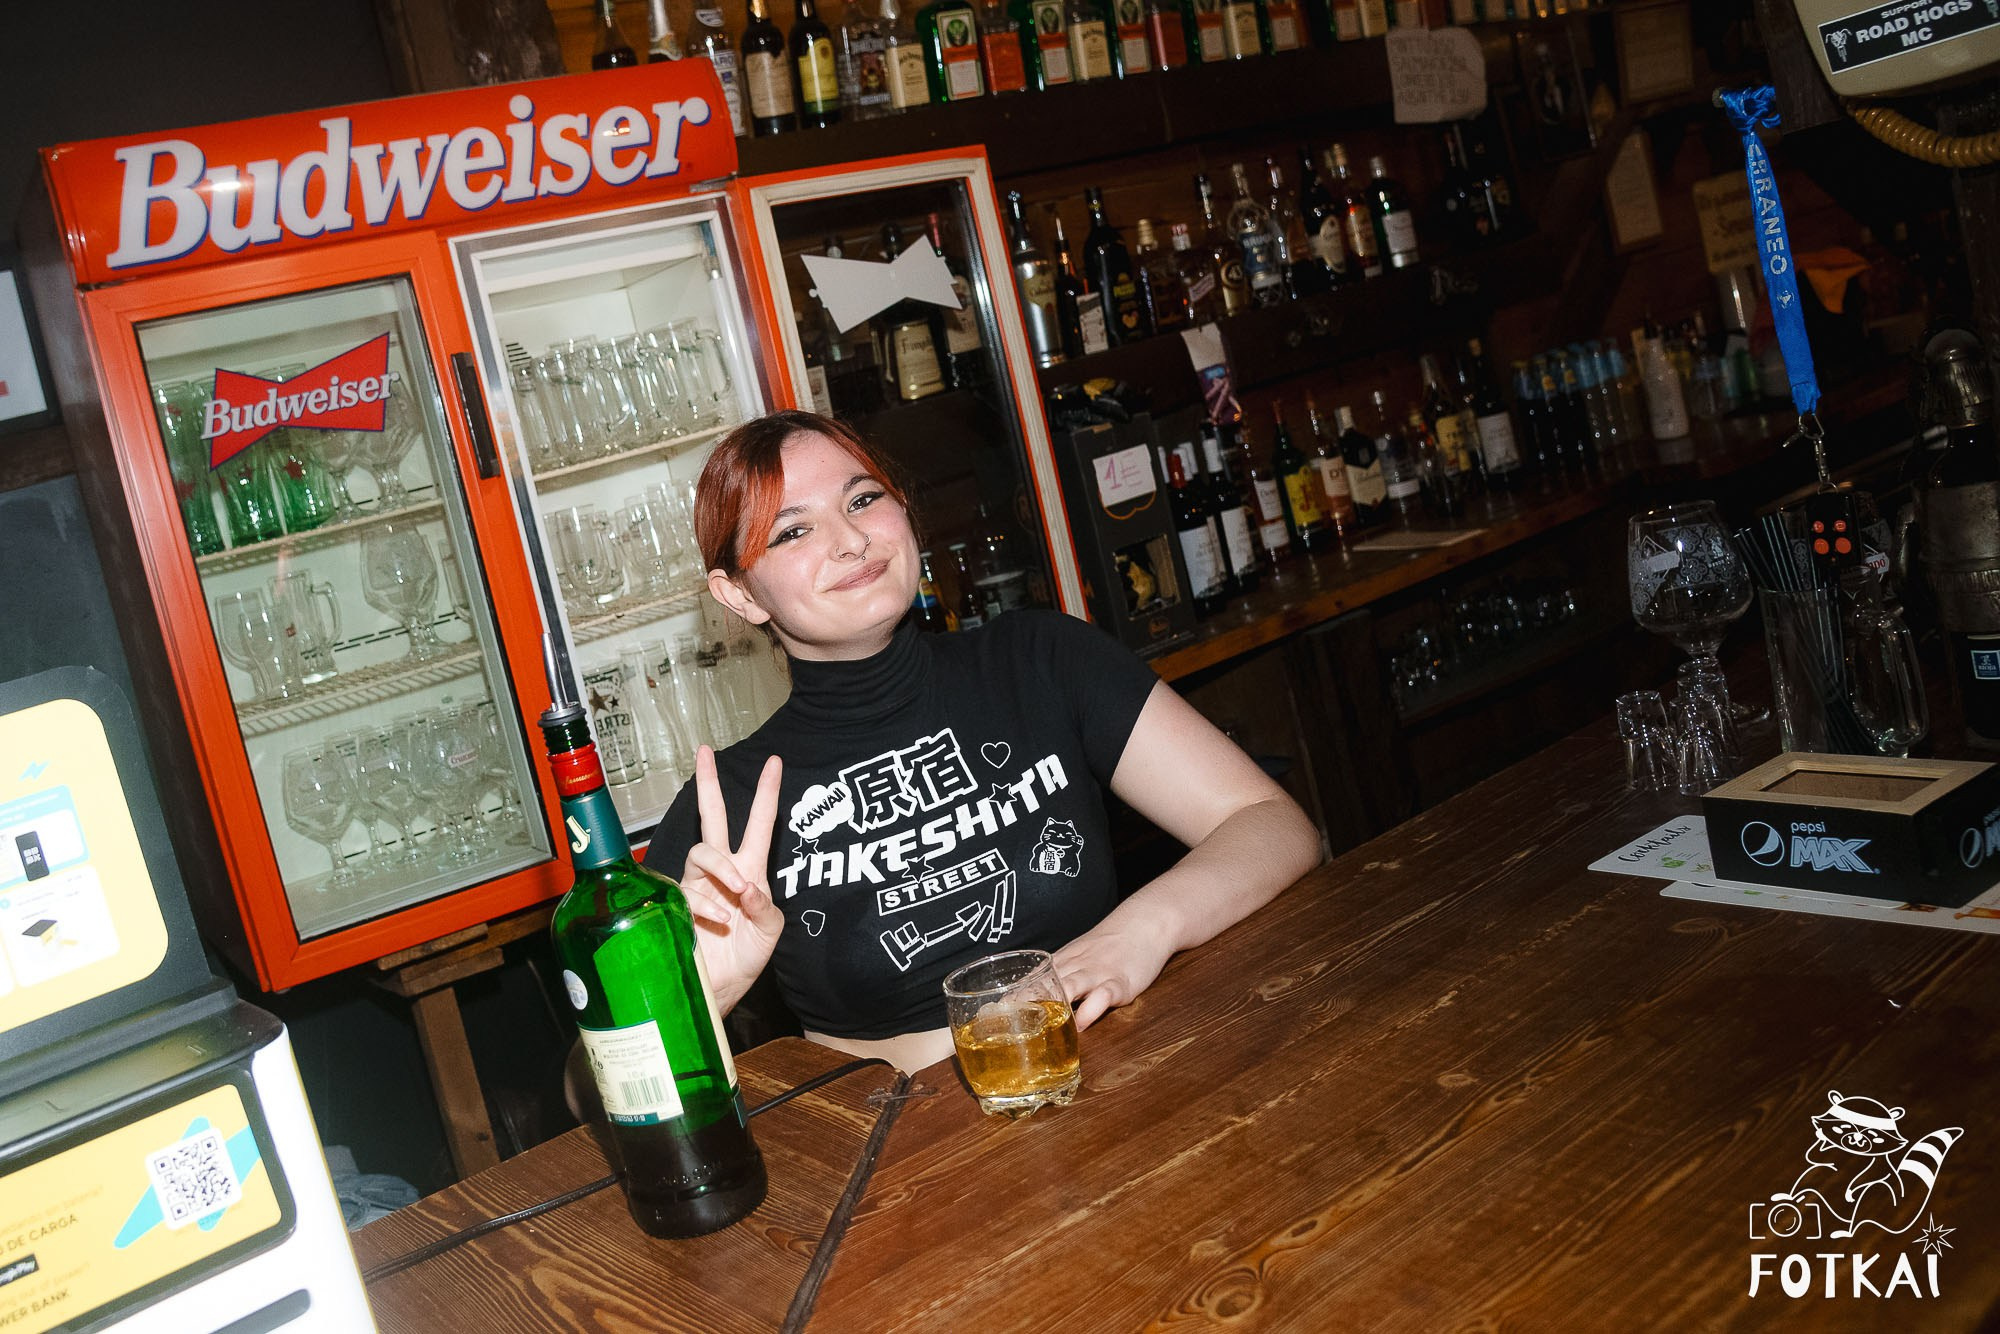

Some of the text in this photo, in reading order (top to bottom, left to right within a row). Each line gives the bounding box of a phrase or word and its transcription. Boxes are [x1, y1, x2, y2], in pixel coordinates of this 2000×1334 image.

[1856, 0, 1973, 43] ROAD HOGS
[1900, 27, 1933, 47] MC
[107, 95, 711, 269] Budweiser
[200, 371, 401, 440] Budweiser
[839, 727, 978, 834] 原宿
[776, 753, 1069, 899] TAKESHITA
[795, 787, 844, 832] KAWAII
[1790, 821, 1826, 834] pepsi
[1790, 836, 1874, 874] MAX
[885, 856, 998, 908] STREET
[29, 1213, 78, 1242] CARGA
[31, 1288, 70, 1313] BANK
